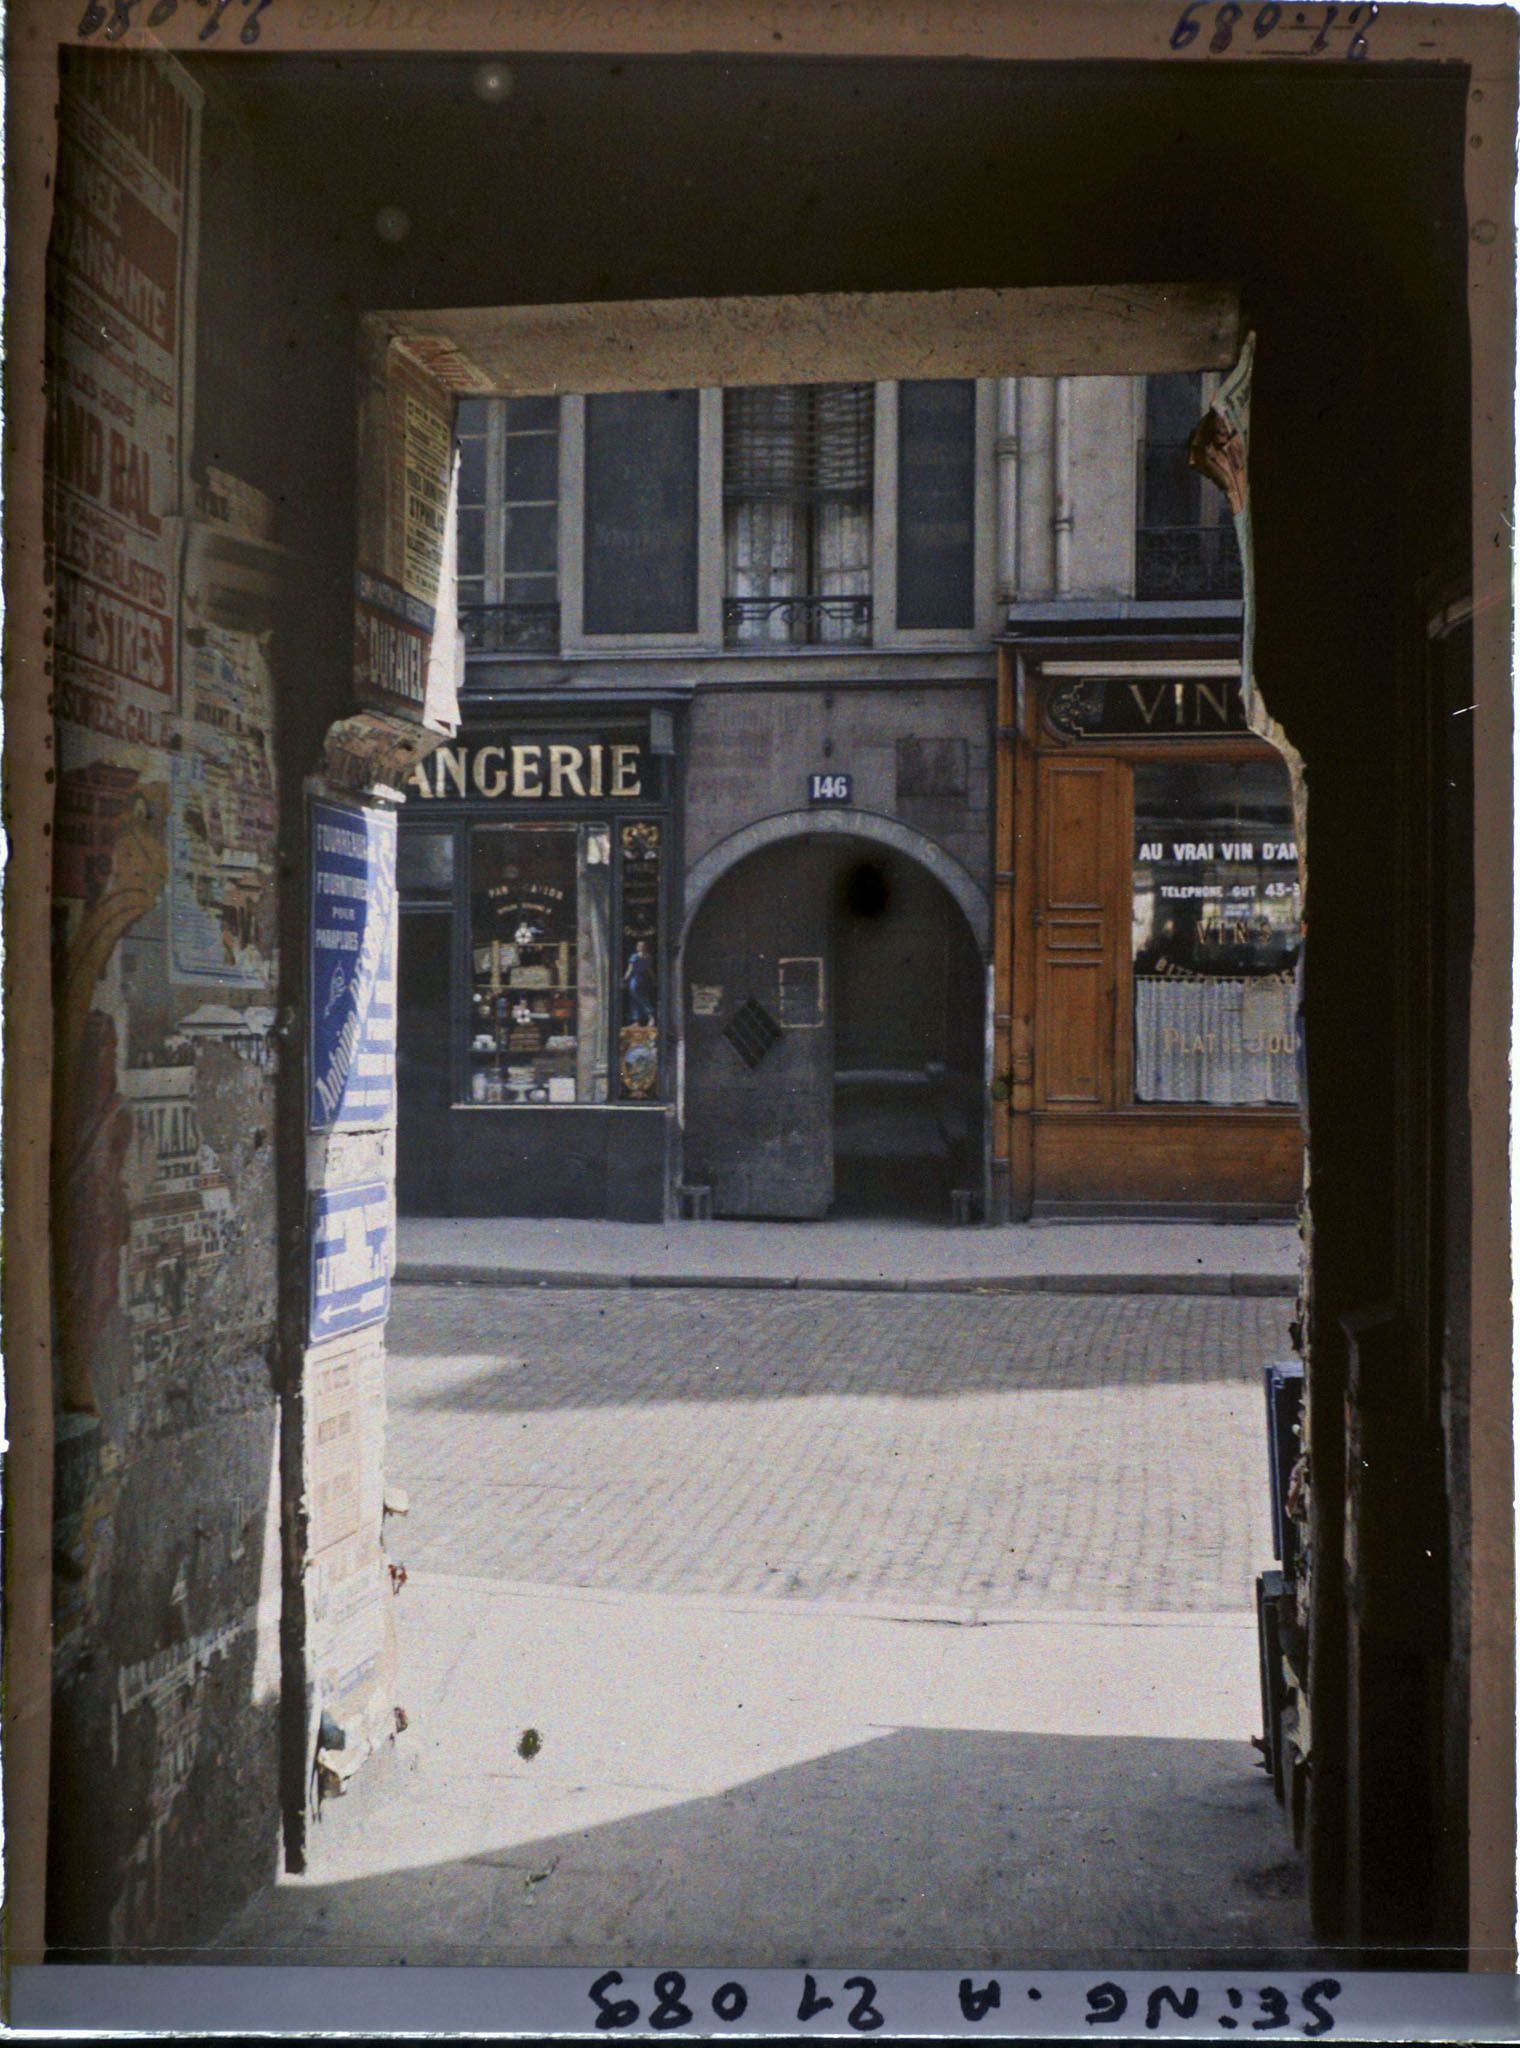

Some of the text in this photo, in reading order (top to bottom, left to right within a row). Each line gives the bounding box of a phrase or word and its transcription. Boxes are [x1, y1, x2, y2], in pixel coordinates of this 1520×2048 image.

[1128, 682, 1245, 725] VIN
[813, 776, 849, 799] 146
[1139, 843, 1163, 861] AU
[1173, 843, 1214, 861] VRAI
[1221, 843, 1253, 860] VIN
[1196, 919, 1273, 945] VINS
[958, 1978, 1000, 2020] A
